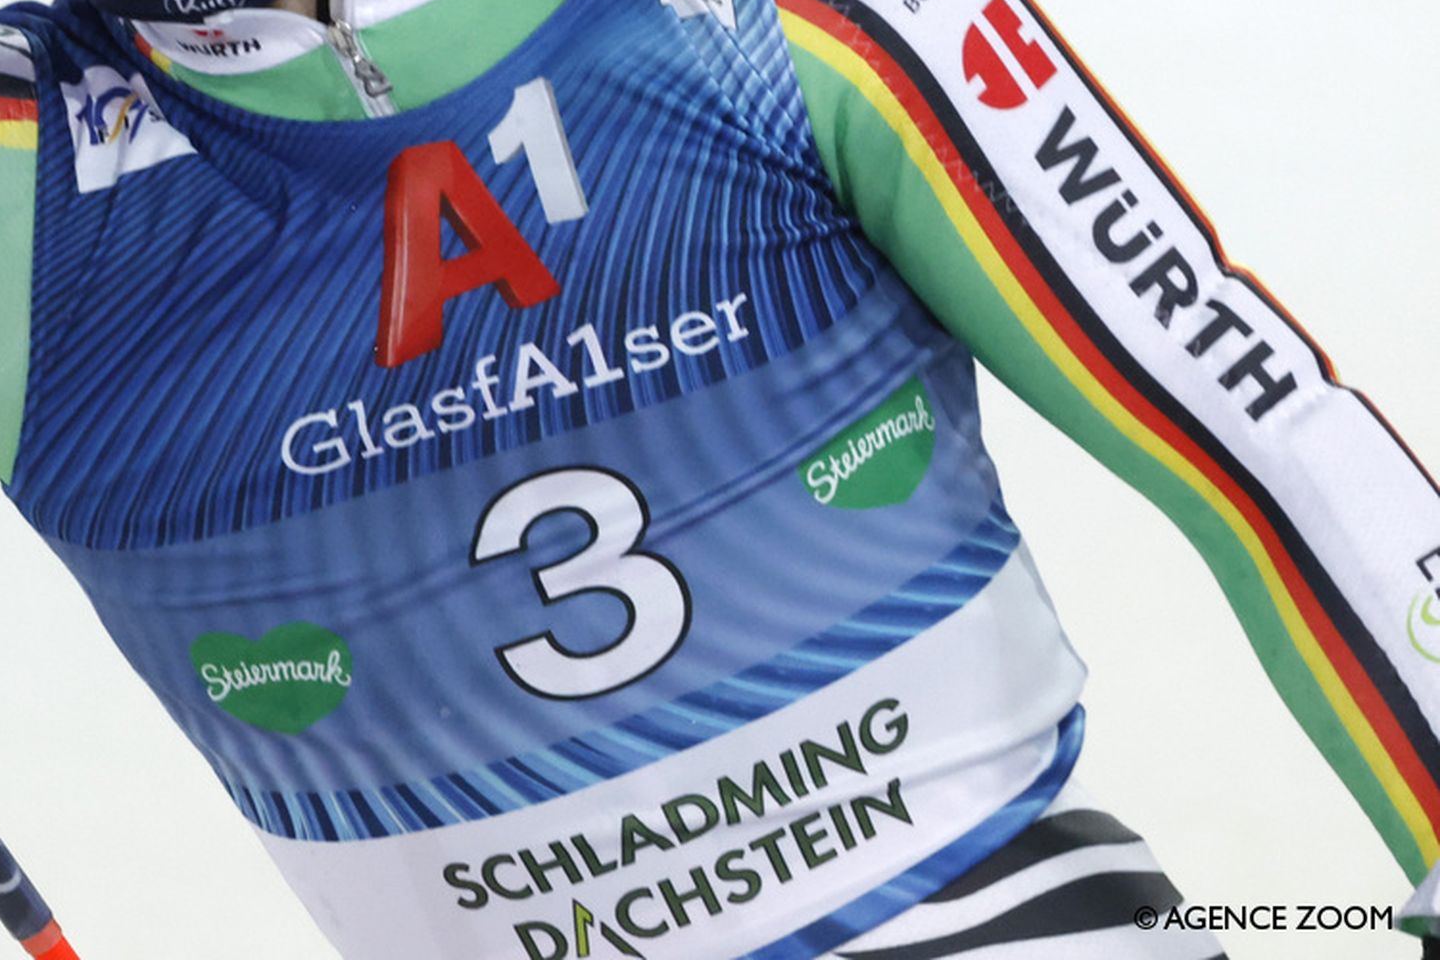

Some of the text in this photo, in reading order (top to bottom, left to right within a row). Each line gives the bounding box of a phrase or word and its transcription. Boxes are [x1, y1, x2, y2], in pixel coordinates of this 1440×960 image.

[375, 75, 590, 368] A1
[1034, 106, 1299, 422] WÜRTH
[281, 292, 751, 476] GlasfA1ser
[805, 392, 936, 506] Steiermark
[201, 650, 352, 702] Steiermark
[469, 464, 693, 702] 3
[442, 697, 911, 910] SCHLADMING
[514, 778, 916, 960] DACHSTEIN
